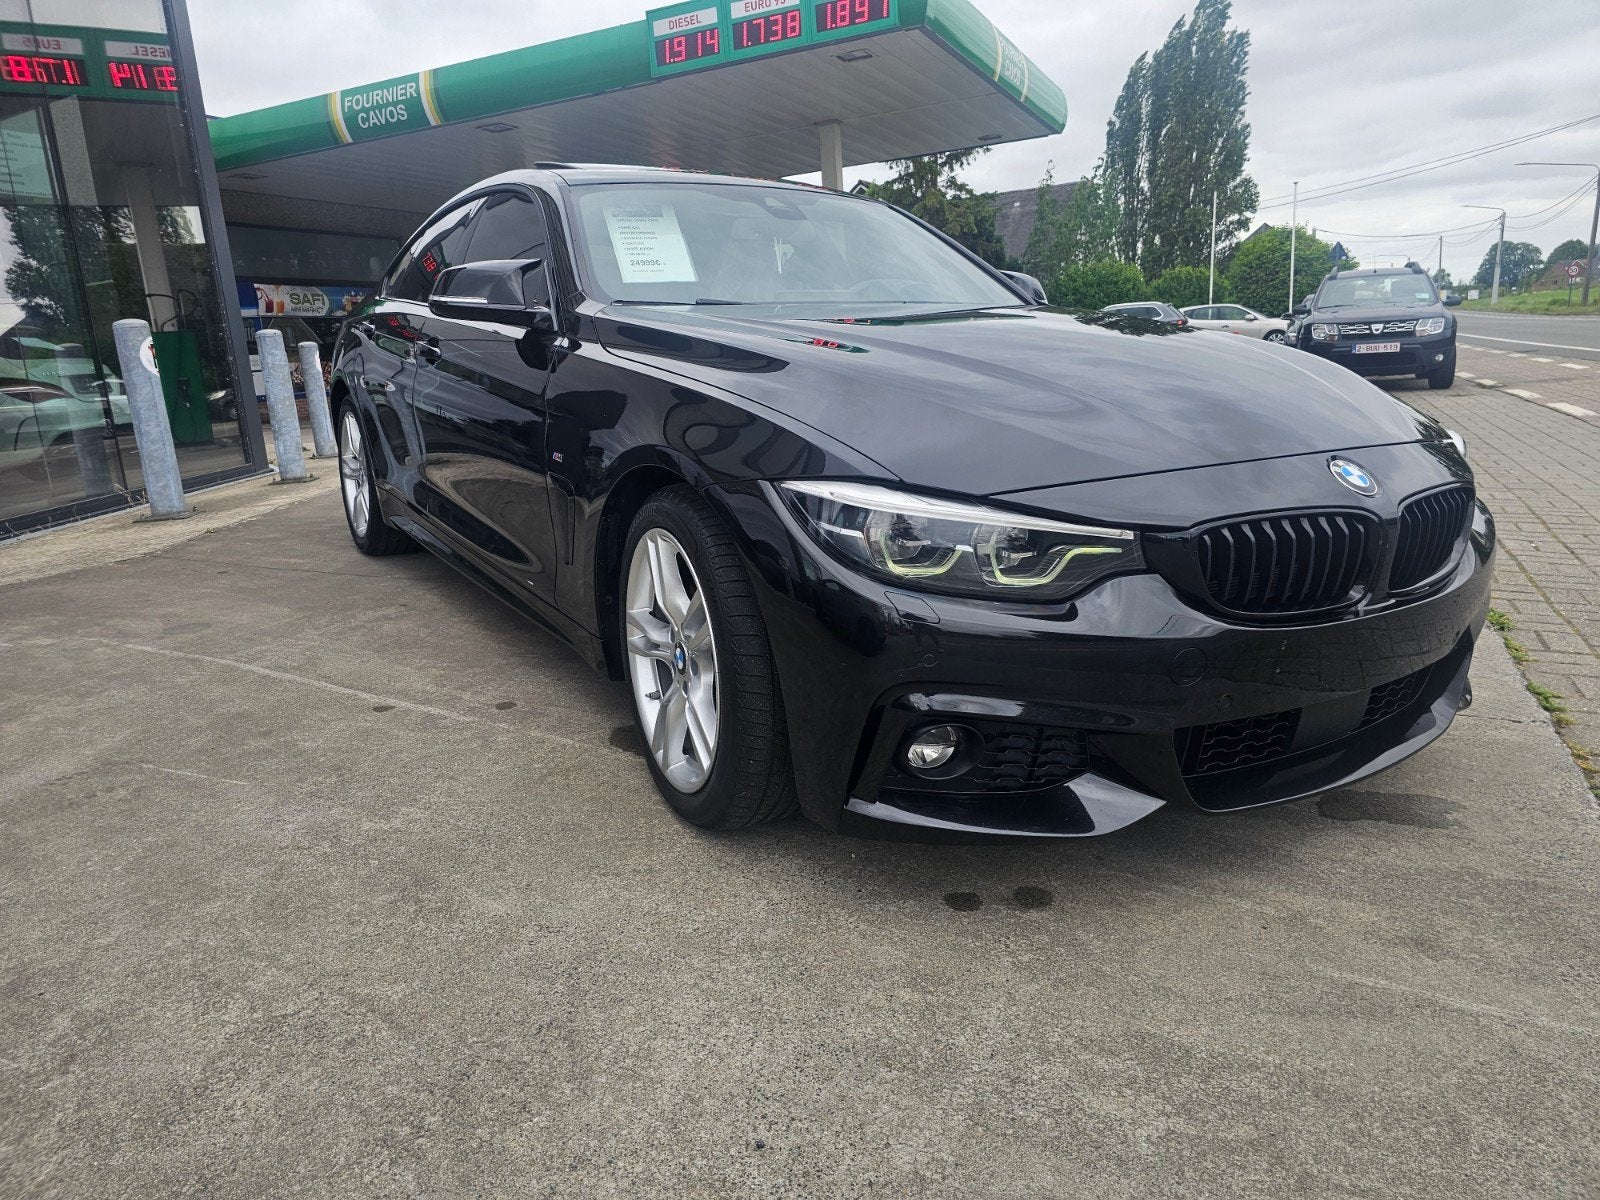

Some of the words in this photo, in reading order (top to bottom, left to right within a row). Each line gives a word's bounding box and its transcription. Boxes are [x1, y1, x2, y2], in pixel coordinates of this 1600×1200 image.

[744, 0, 771, 13] EURO
[668, 14, 702, 30] DIESEL
[742, 10, 800, 47] 1.738
[665, 28, 719, 64] 1.914
[344, 82, 417, 112] FOURNIER
[358, 104, 408, 129] CAVOS
[290, 293, 325, 306] SAFI
